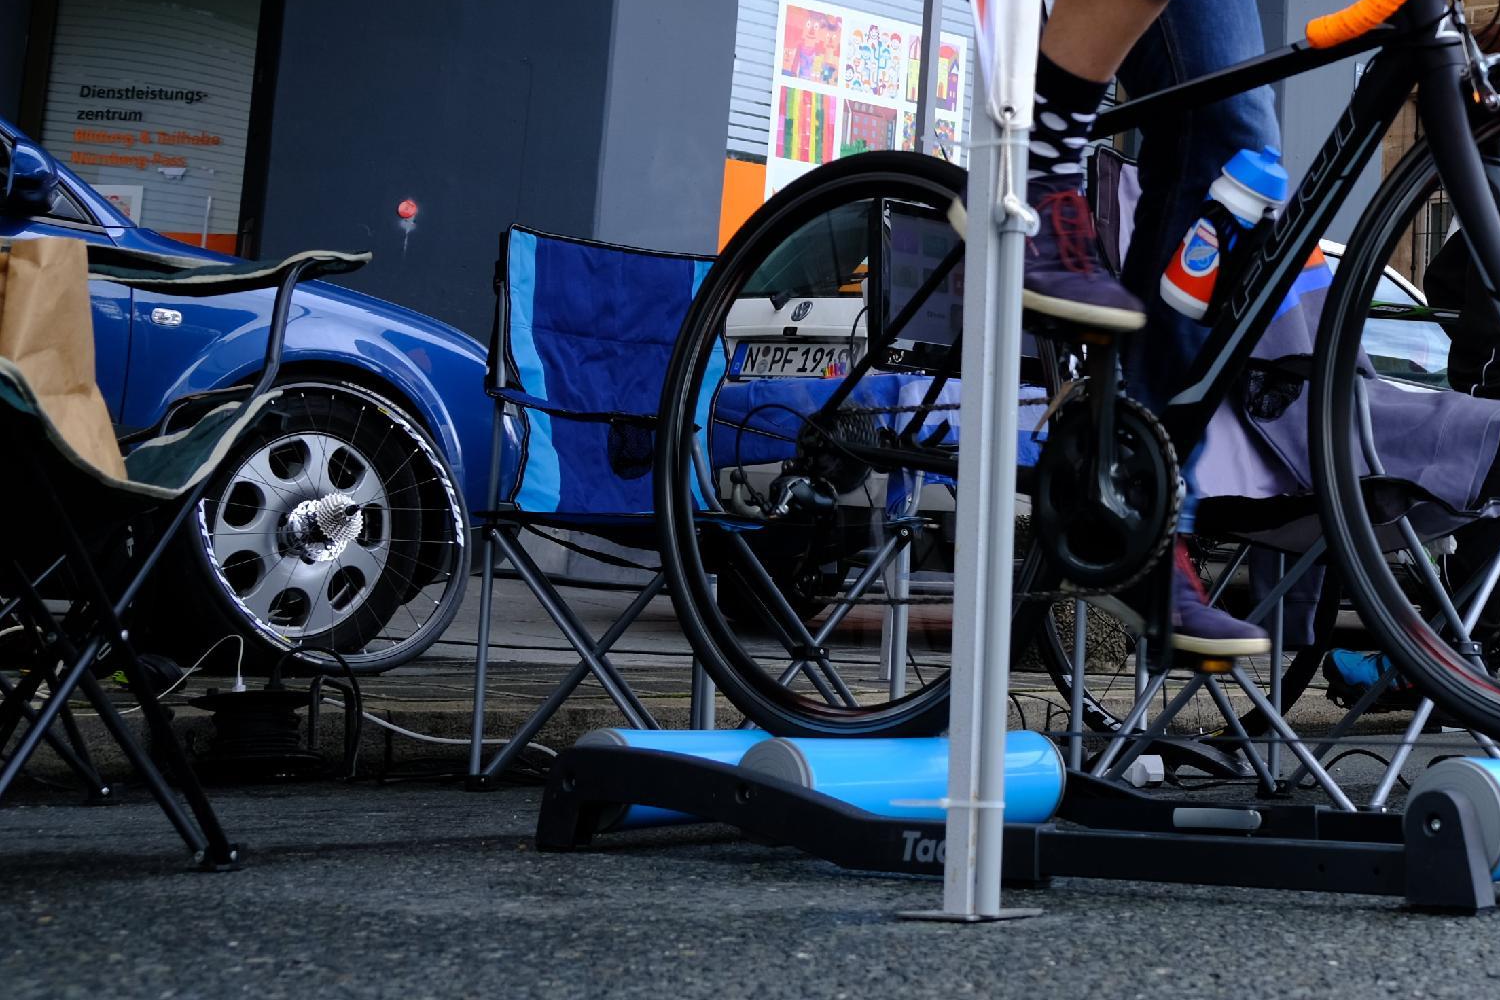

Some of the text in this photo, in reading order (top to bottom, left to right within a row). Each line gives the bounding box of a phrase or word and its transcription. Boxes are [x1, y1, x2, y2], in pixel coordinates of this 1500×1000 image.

[79, 85, 209, 105] Dienstleistungs-
[76, 107, 143, 122] zentrum
[768, 346, 799, 373] PF
